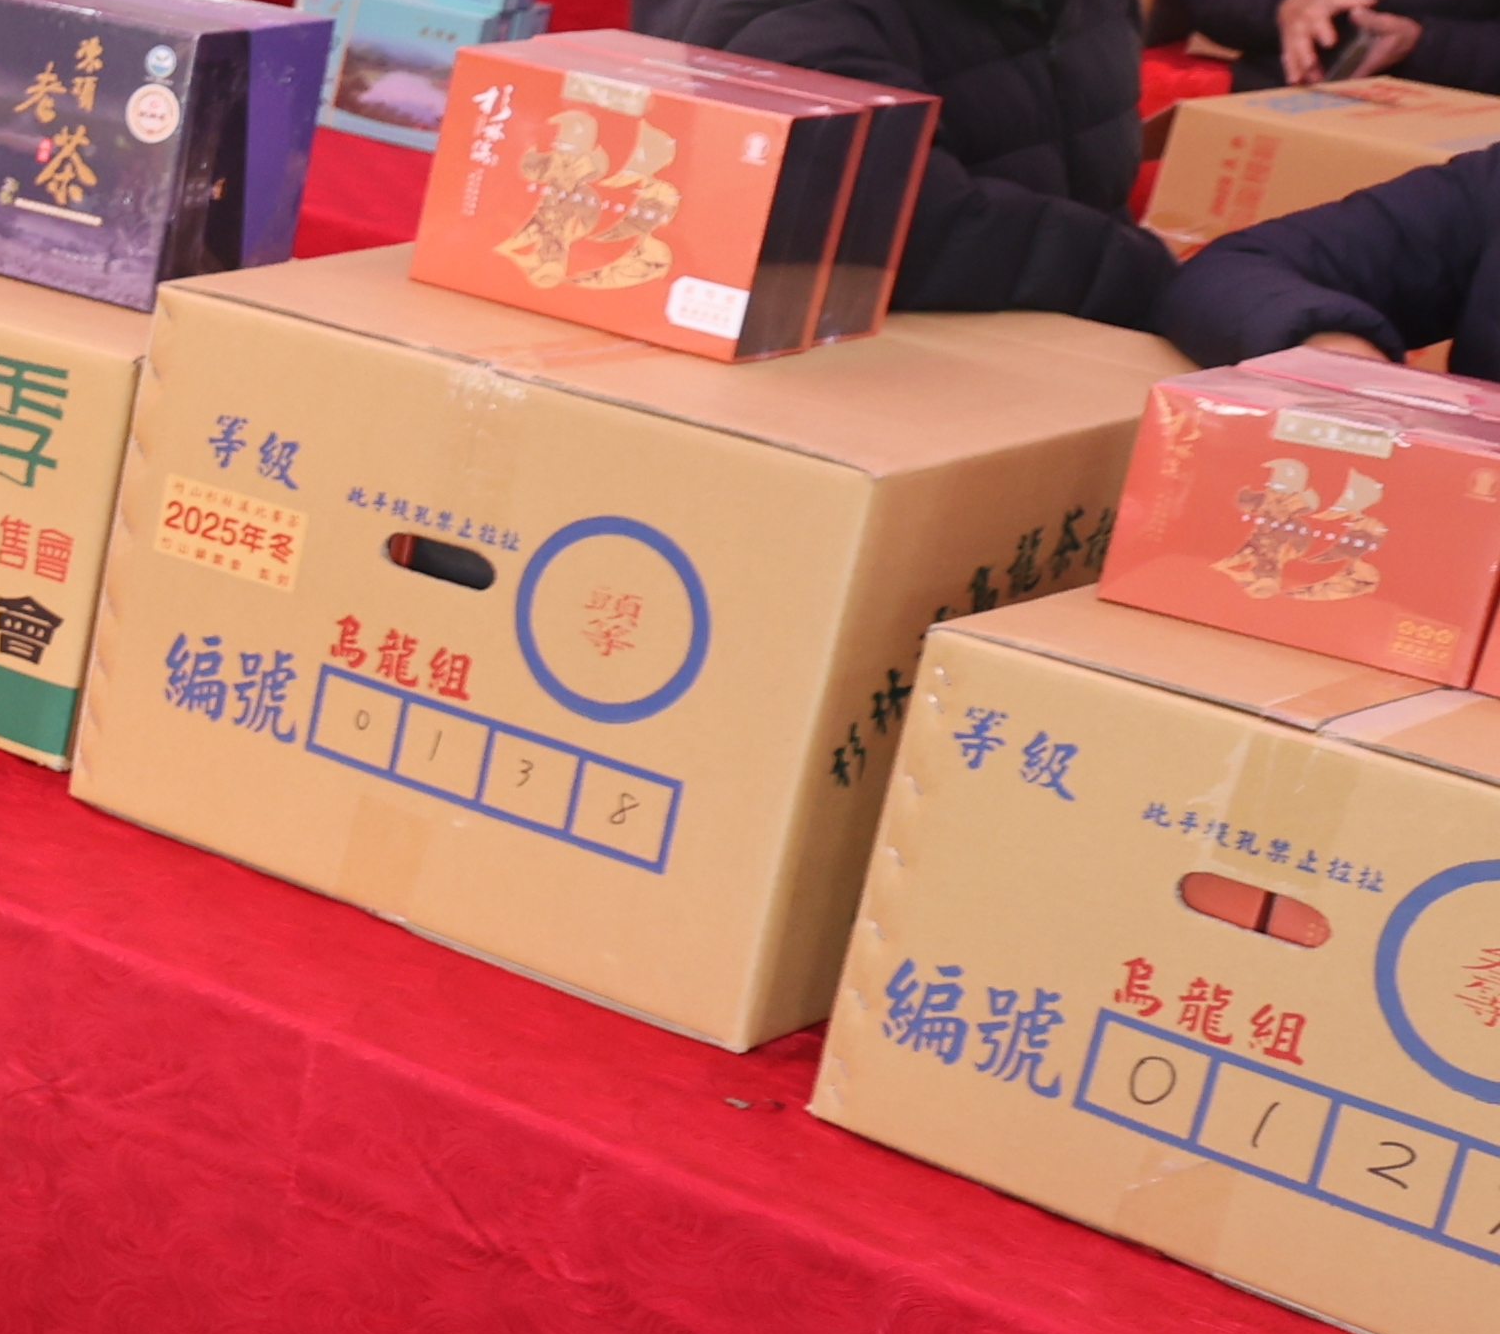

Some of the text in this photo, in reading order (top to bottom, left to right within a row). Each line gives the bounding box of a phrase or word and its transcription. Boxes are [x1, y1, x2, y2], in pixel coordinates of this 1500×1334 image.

[208, 415, 301, 490] 等級
[164, 500, 296, 565] 2025年冬
[164, 632, 298, 744] 編號
[329, 613, 473, 702] 烏龍組
[953, 706, 1079, 802] 等級
[1141, 801, 1386, 894] 此手提孔禁止拉扯
[880, 956, 1066, 1099] 編號
[1112, 956, 1308, 1066] 烏龍組
